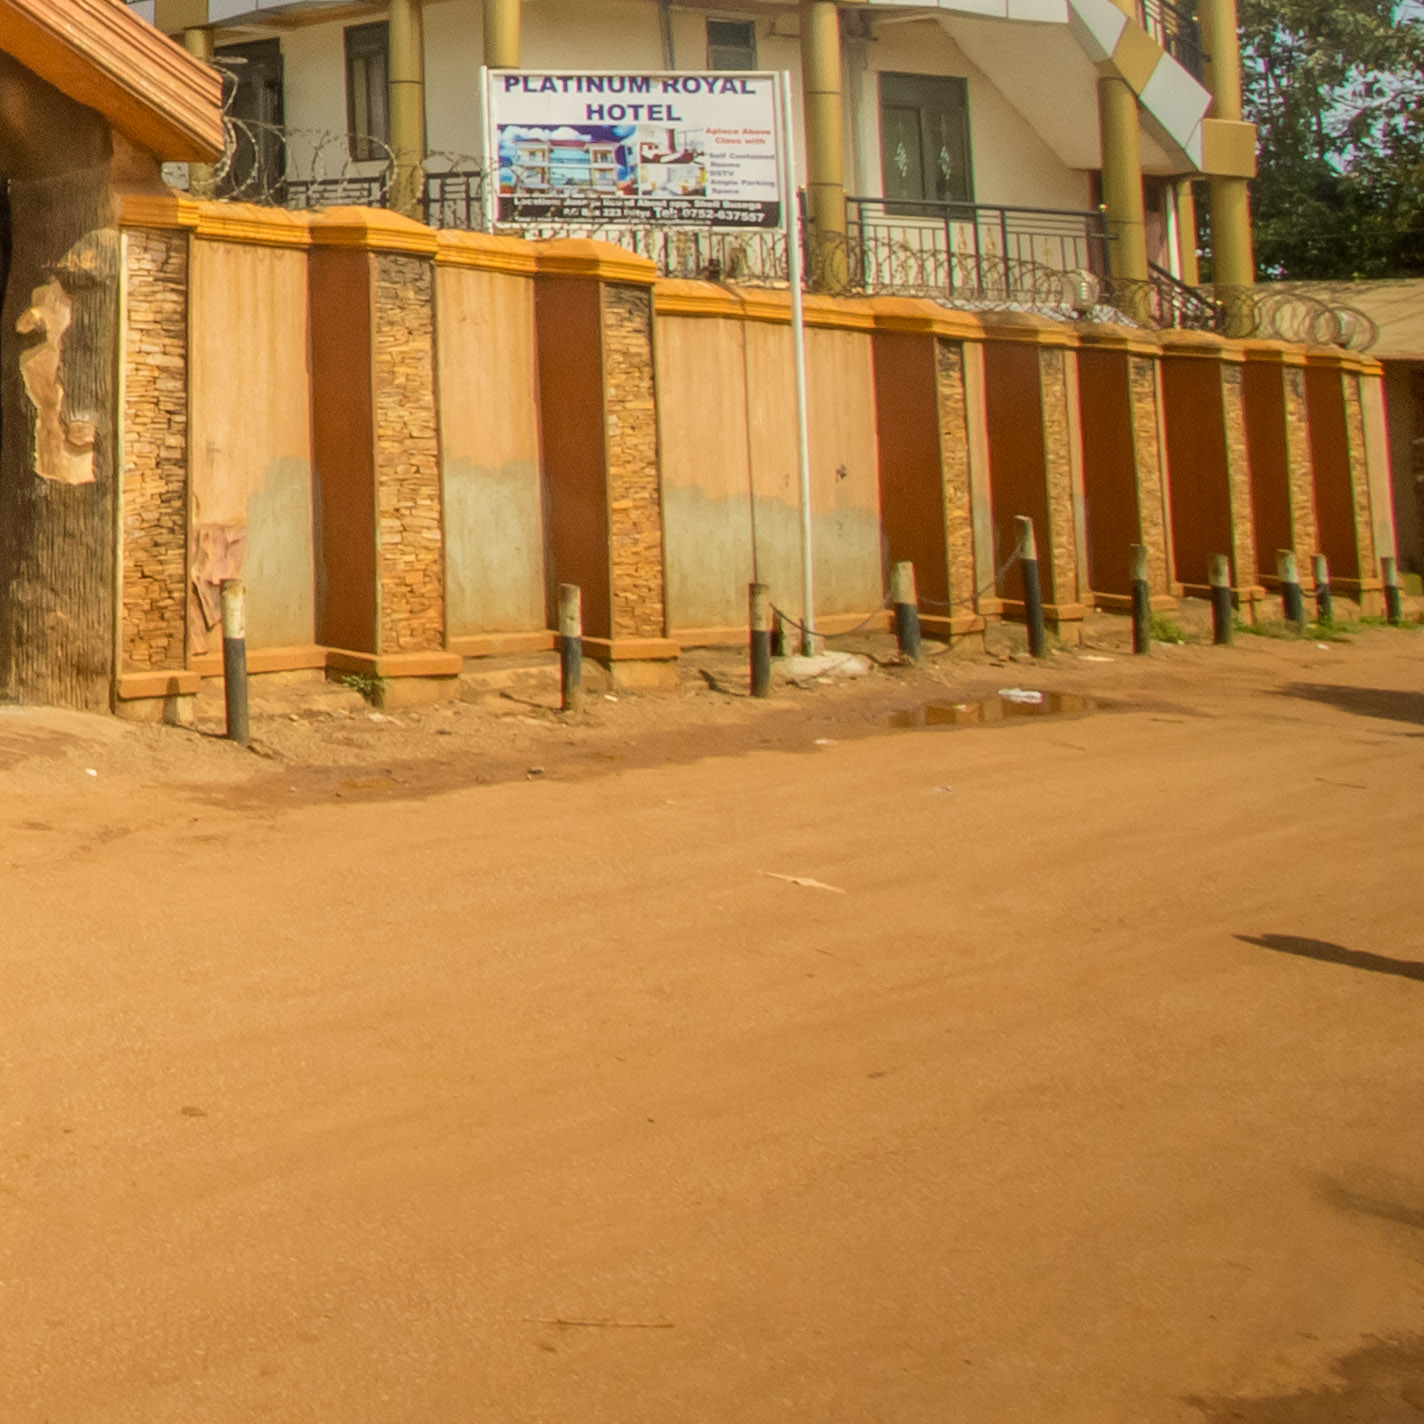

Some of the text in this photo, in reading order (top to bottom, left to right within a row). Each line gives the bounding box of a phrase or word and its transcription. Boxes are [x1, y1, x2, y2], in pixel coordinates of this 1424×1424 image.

[504, 76, 756, 94] PLATINUM ROYAL
[586, 104, 682, 121] HOTEL
